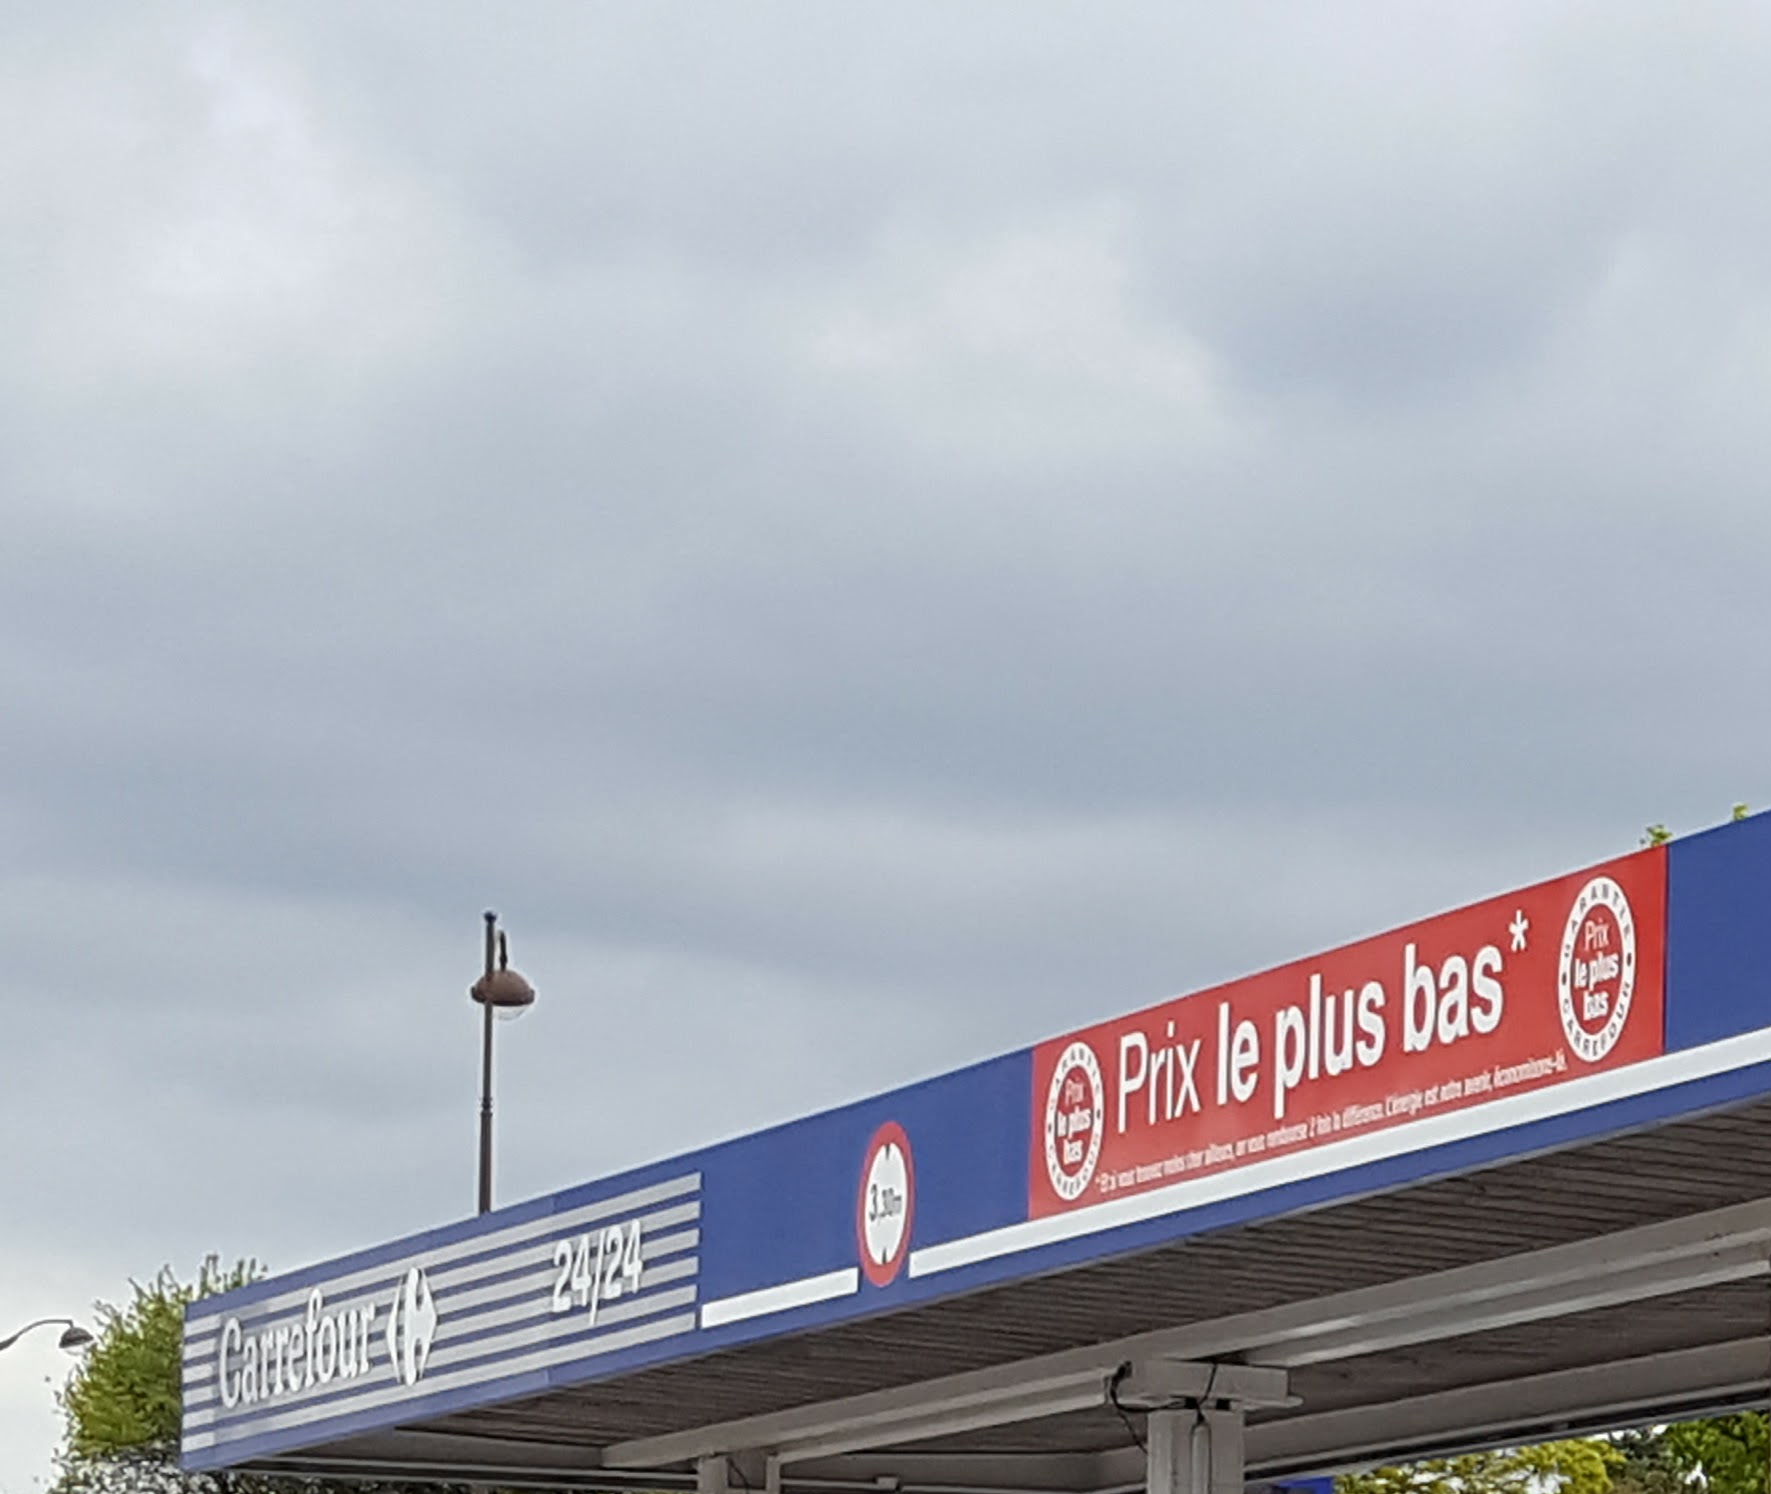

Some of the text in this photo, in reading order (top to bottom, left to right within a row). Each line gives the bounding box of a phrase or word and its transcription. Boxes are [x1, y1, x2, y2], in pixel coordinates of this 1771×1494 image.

[1575, 951, 1619, 991] le plus
[1585, 917, 1609, 951] Prix
[1118, 1022, 1202, 1134] Prix
[1217, 1002, 1258, 1106] le
[1274, 974, 1386, 1118] plus
[551, 1220, 644, 1326] 24/24
[218, 1288, 376, 1410] Carrefour
